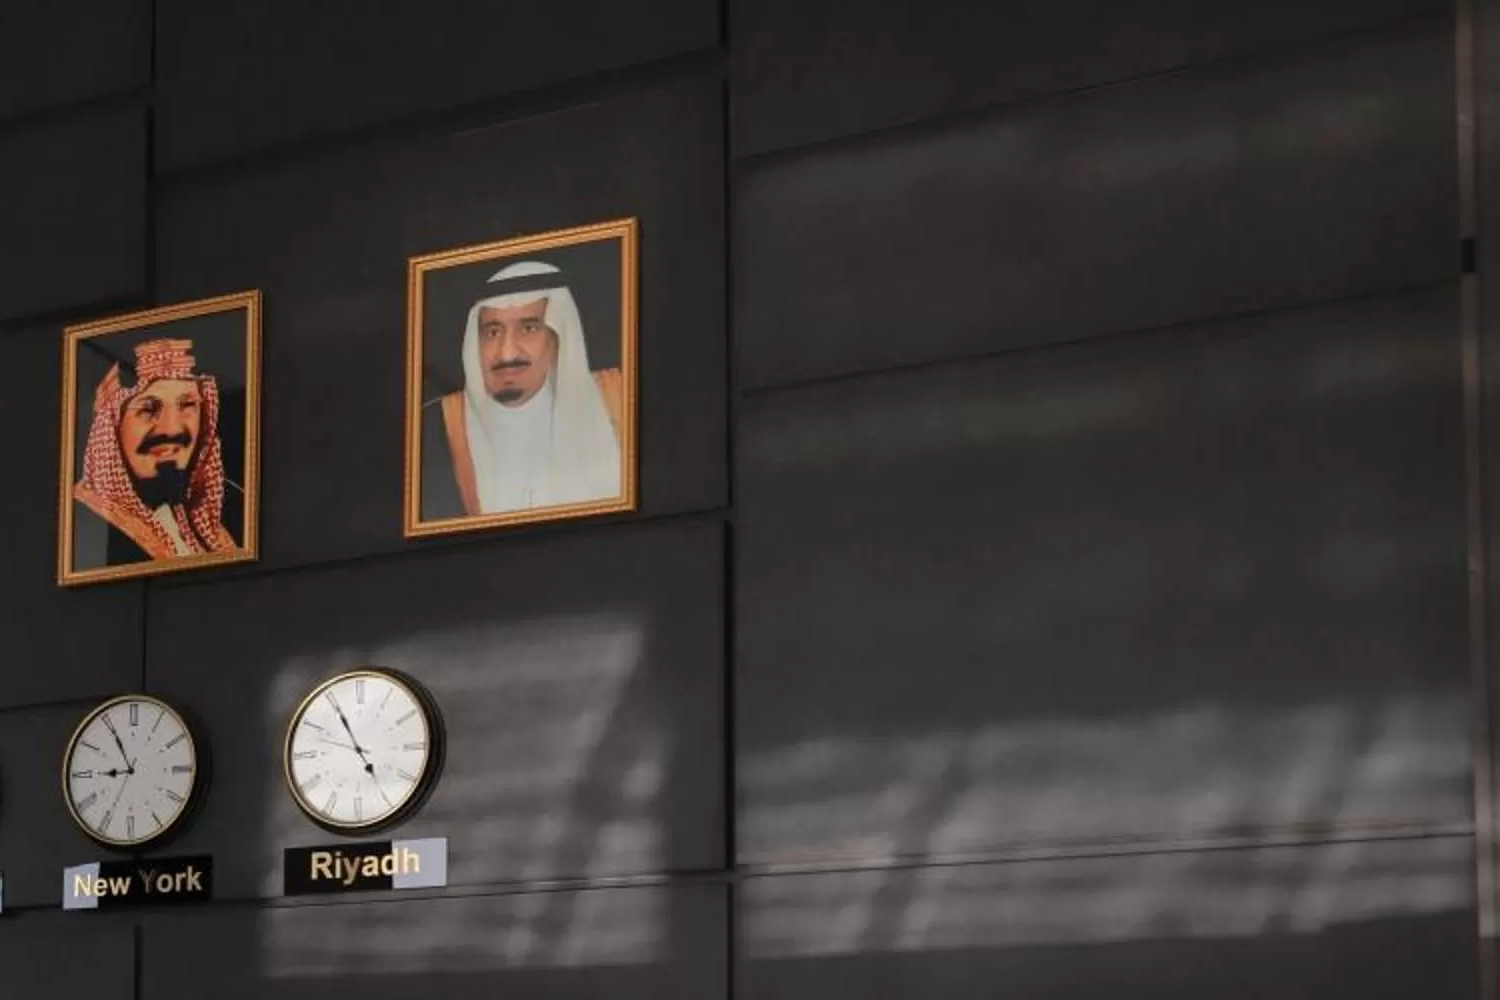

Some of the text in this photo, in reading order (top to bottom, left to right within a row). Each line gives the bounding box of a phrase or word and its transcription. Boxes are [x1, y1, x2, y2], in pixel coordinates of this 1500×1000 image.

[74, 865, 203, 897] New York
[311, 847, 420, 885] Riyadh
